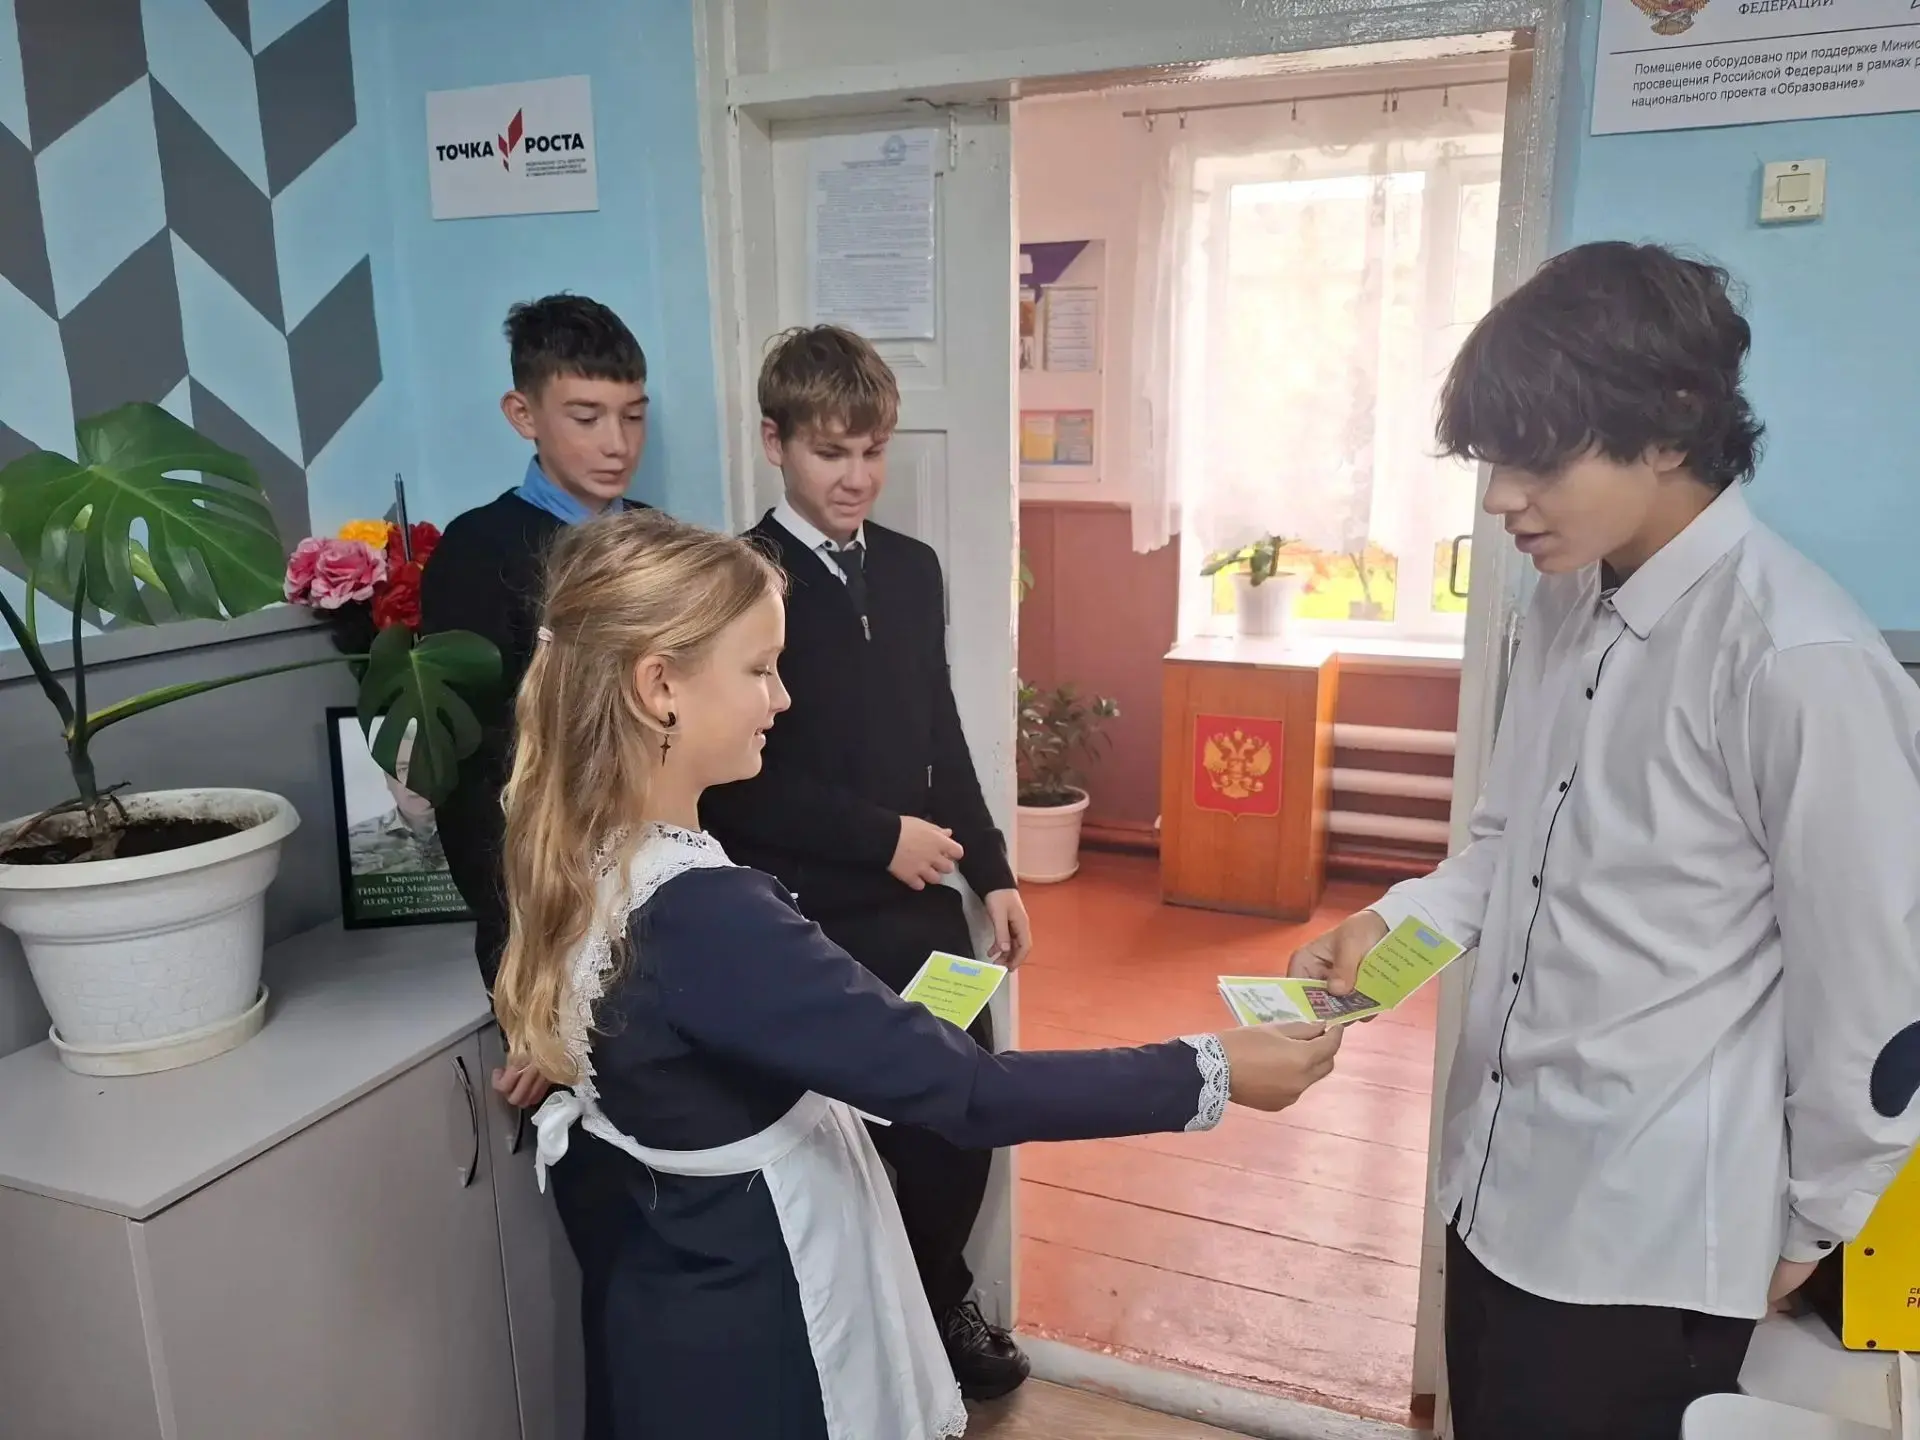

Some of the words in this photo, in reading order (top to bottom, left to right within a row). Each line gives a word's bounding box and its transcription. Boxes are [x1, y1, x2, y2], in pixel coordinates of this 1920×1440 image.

[1635, 59, 1702, 75] Помещение
[1705, 52, 1782, 70] оборудовано
[1786, 51, 1807, 62] при
[1811, 43, 1877, 59] поддержке
[1633, 75, 1709, 92] просвещения
[1713, 67, 1781, 84] Российской
[1785, 63, 1853, 78] Федерации
[1857, 62, 1863, 71] в
[1867, 57, 1911, 73] рамках
[1632, 91, 1717, 108] национального
[1721, 86, 1766, 102] проекта
[1771, 79, 1865, 95] «Образование»
[436, 141, 494, 161] ТОЧКА
[525, 133, 584, 153] РОСТА
